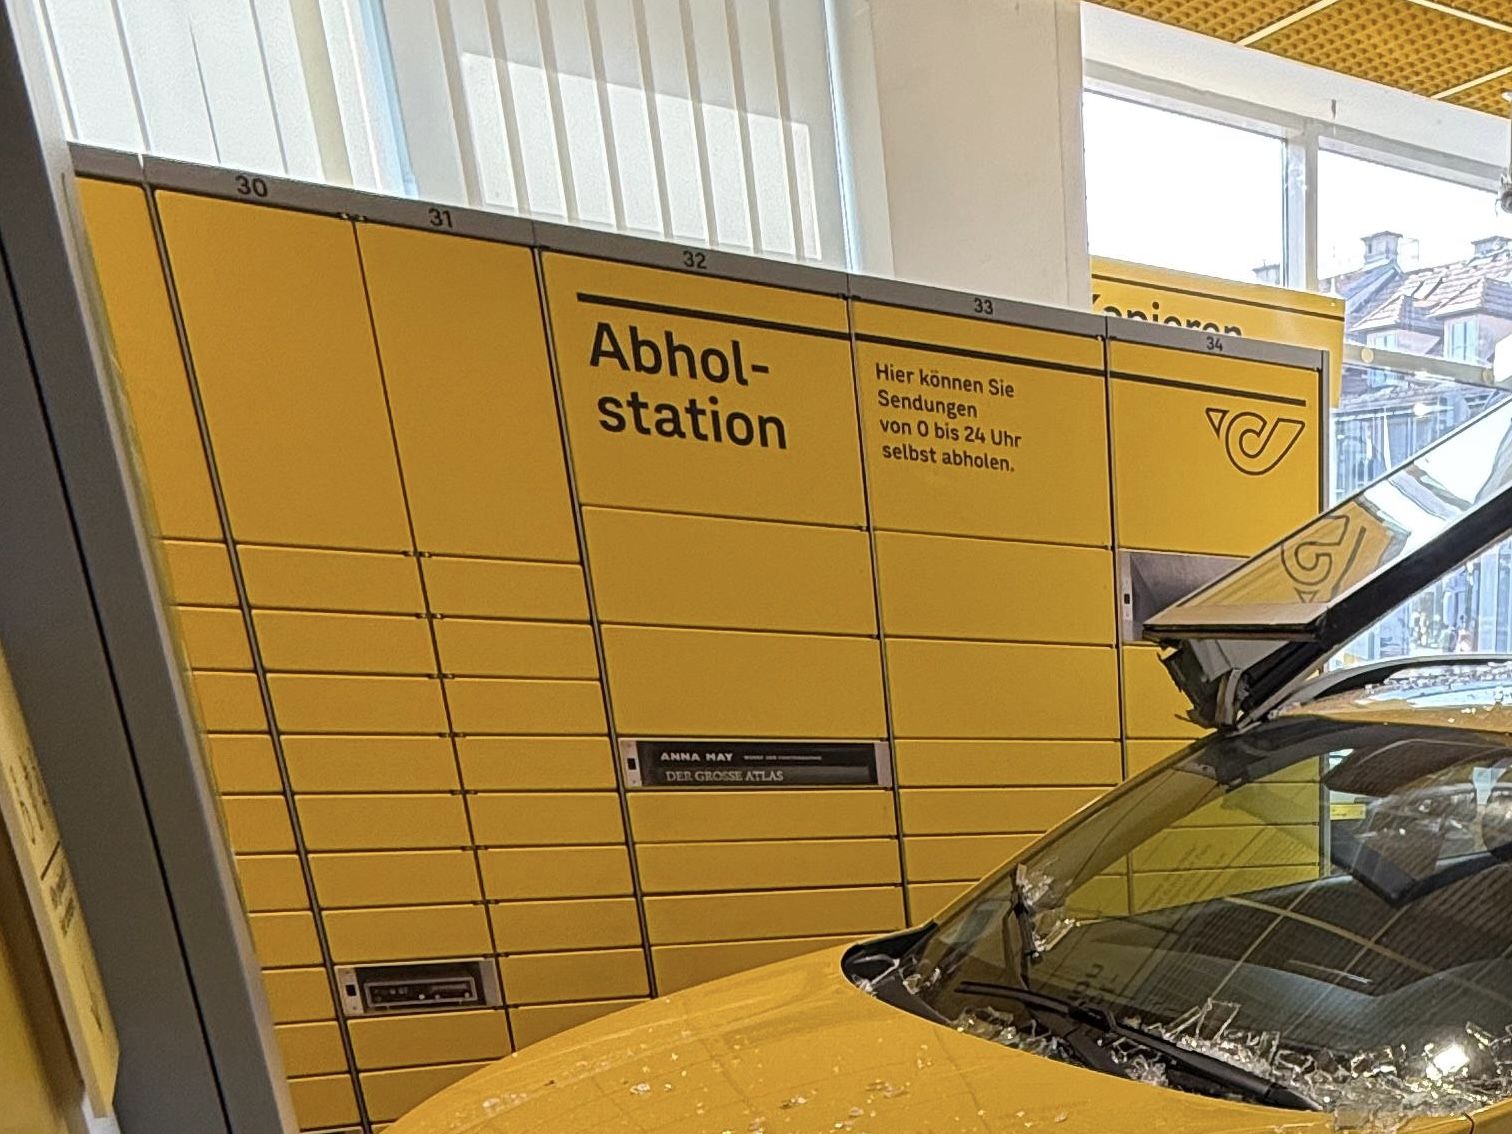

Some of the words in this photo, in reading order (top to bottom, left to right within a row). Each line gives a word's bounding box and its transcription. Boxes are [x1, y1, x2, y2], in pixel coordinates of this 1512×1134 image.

[235, 175, 268, 198] 30
[428, 208, 453, 228] 31
[682, 250, 708, 270] 32
[974, 297, 994, 315] 33
[590, 321, 770, 387] Abhol-
[1206, 335, 1224, 352] 34
[875, 362, 914, 385] Hier
[919, 368, 984, 394] können
[988, 377, 1015, 398] Sie
[877, 388, 978, 420] Sendungen
[597, 391, 787, 450] station
[879, 418, 912, 435] von
[934, 421, 960, 442] bis
[964, 426, 986, 444] 24
[991, 428, 1022, 448] Uhr
[882, 443, 937, 464] selbst
[942, 449, 1015, 473] abholen.
[660, 751, 701, 762] ANNA
[665, 770, 693, 782] DER
[695, 770, 743, 783] GROSSE
[745, 770, 784, 782] ATLAS
